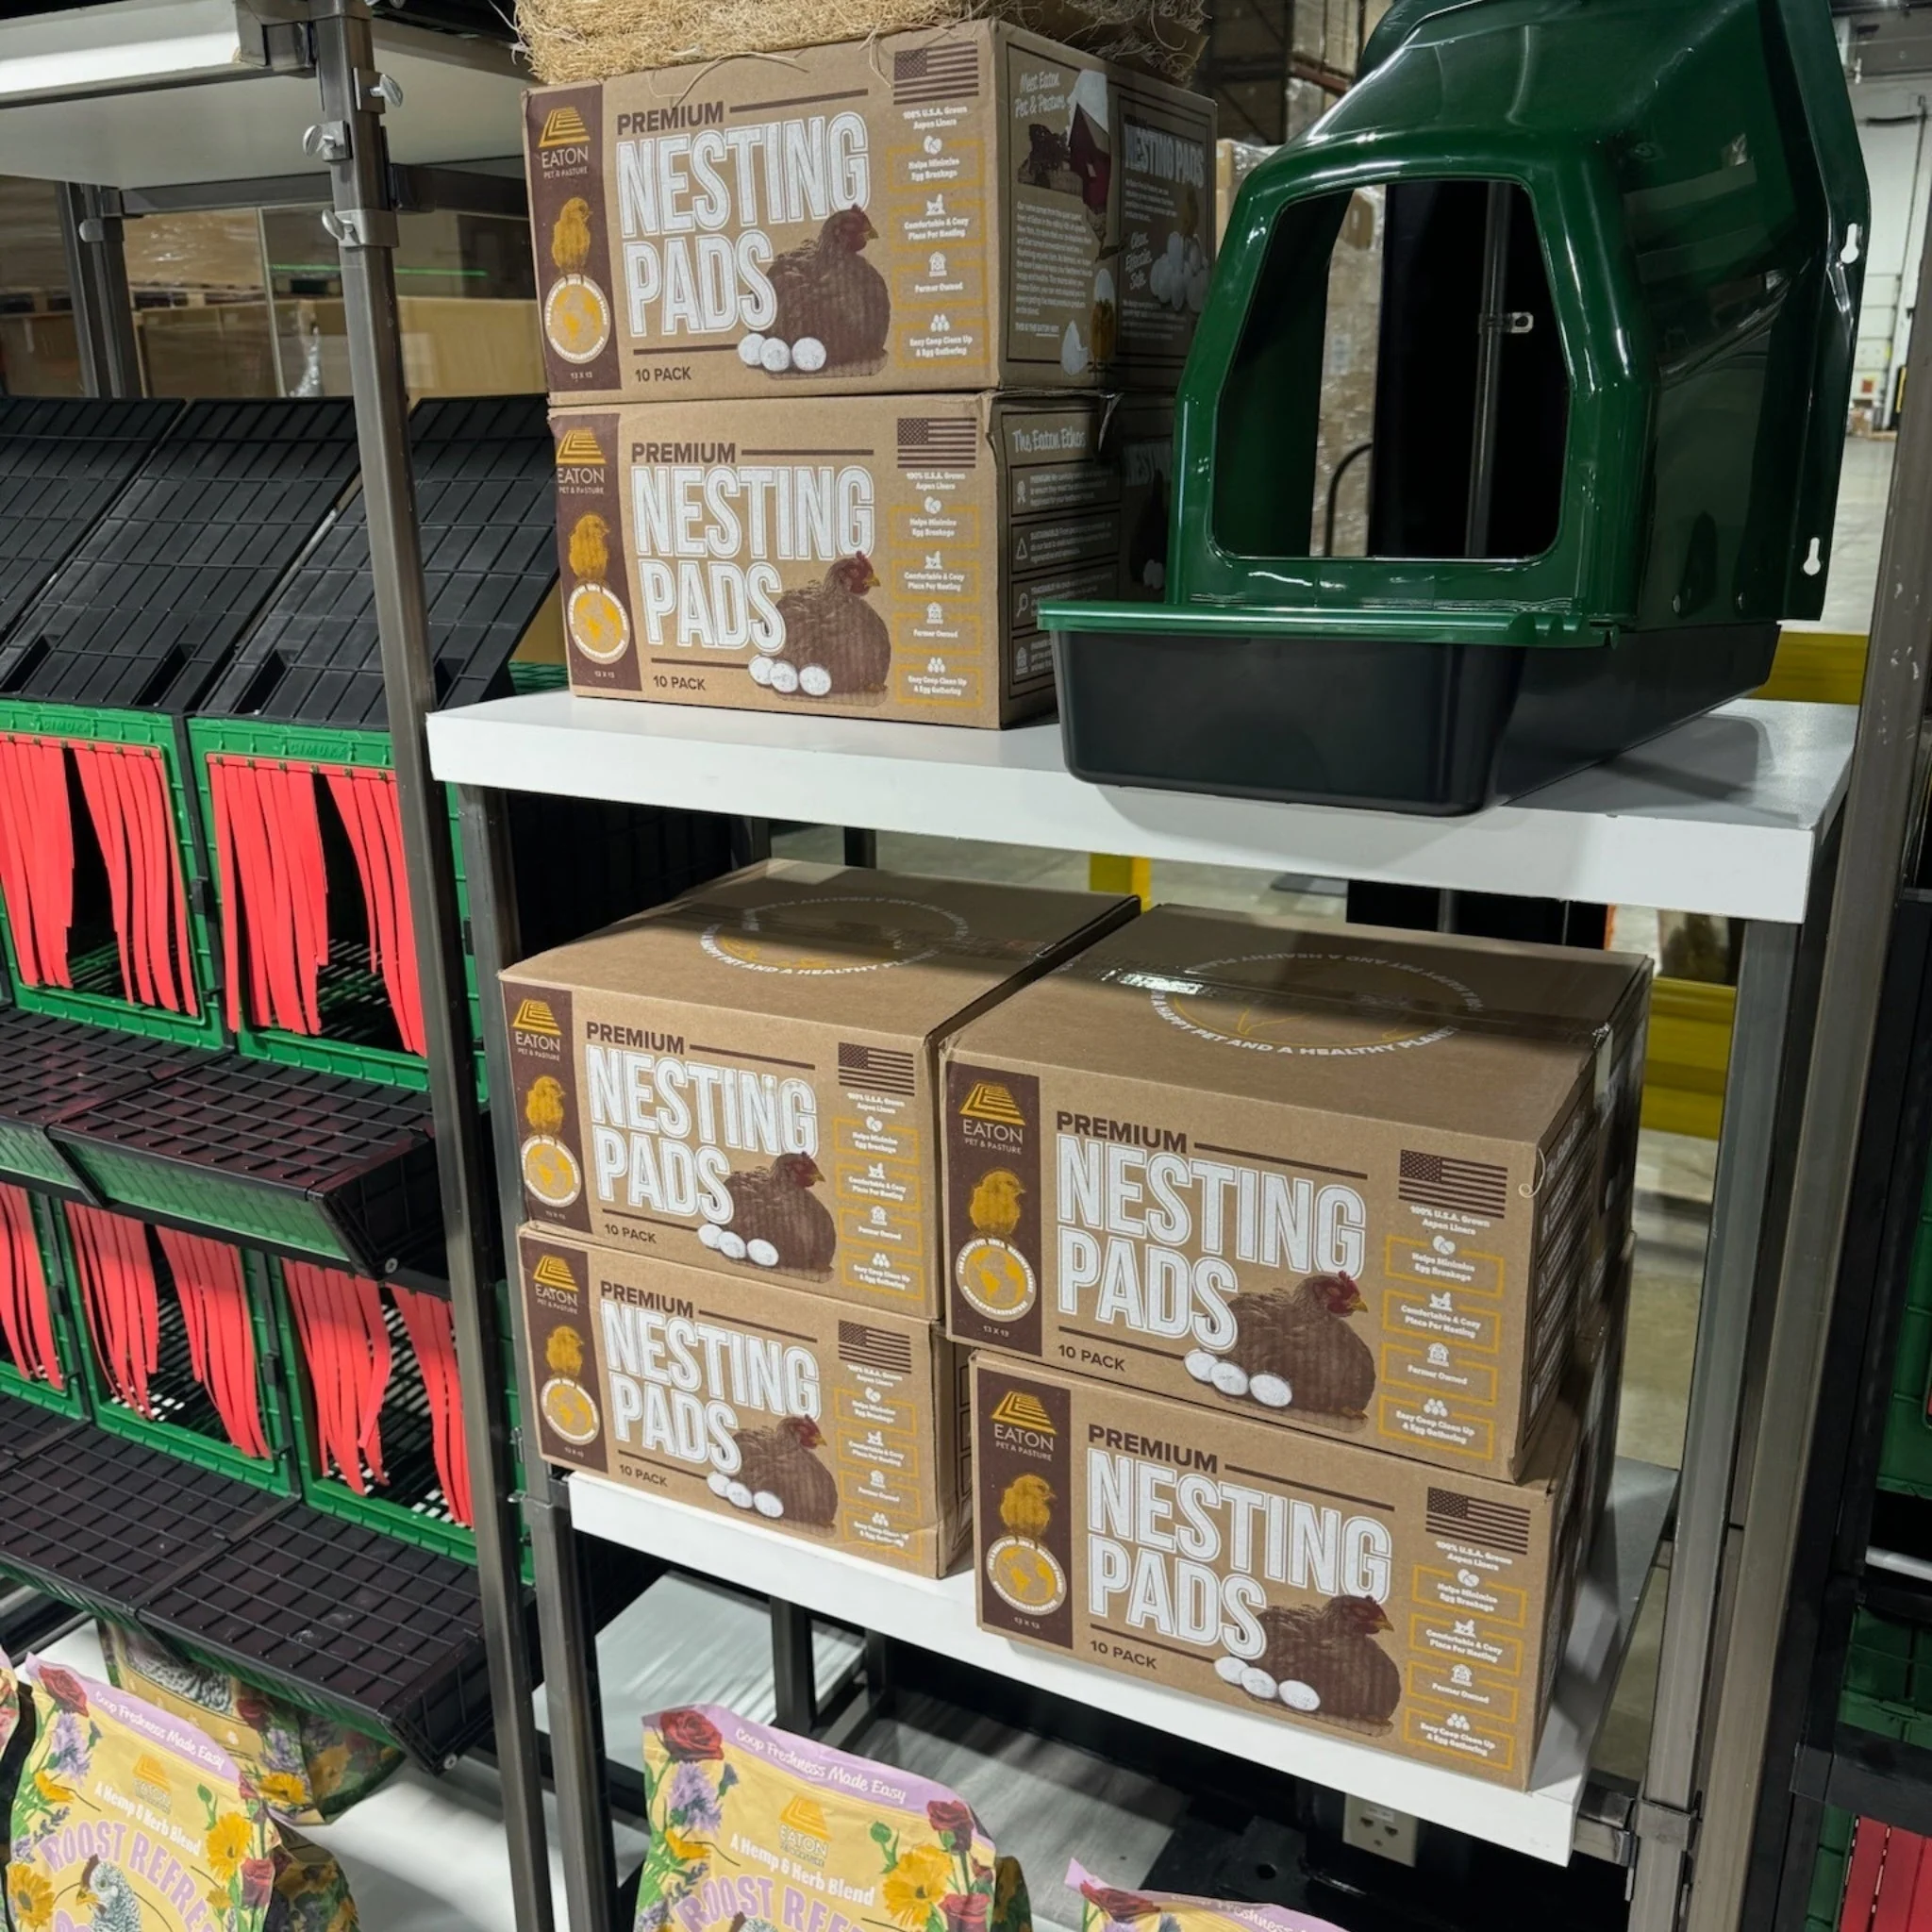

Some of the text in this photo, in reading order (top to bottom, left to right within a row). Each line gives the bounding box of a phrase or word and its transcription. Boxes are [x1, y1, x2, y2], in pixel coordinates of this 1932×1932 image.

[617, 101, 724, 135] PREMIUM
[541, 145, 589, 169] EATON
[616, 111, 870, 238] NESTING
[623, 229, 777, 338] PADS
[635, 366, 691, 382] 10 PACK
[631, 442, 736, 463] PREMIUM
[558, 468, 605, 485] EATON
[630, 466, 874, 561] NESTING
[638, 559, 787, 653] PADS
[653, 675, 706, 692] 10 PACK
[796, 964, 878, 975] HEALTHY
[515, 1032, 560, 1053] EATON
[587, 1021, 685, 1055] PREMIUM
[1154, 1006, 1197, 1030] HAPPY
[1190, 1028, 1229, 1042] PET
[1225, 1039, 1274, 1053] AND
[1277, 1045, 1293, 1055] A
[1300, 1043, 1395, 1057] HEALTHY
[1397, 1025, 1459, 1049] PLANET
[586, 1043, 819, 1158] NESTING
[963, 1119, 1024, 1144] EATON
[965, 1138, 1022, 1156] PET & PASTURE
[1057, 1110, 1187, 1154] PREMIUM
[592, 1124, 734, 1225] PADS
[1057, 1132, 1366, 1281] NESTING
[1434, 1210, 1460, 1223] U.S.A.
[1461, 1215, 1491, 1228] Grown
[605, 1224, 657, 1244] 10 PACK
[1422, 1219, 1476, 1236] Aspen Liners
[535, 1284, 578, 1307] EATON
[600, 1280, 693, 1319] PREMIUM
[1058, 1224, 1239, 1355] PADS
[600, 1298, 821, 1422] NESTING
[1058, 1344, 1125, 1373] 10 PACK
[609, 1370, 742, 1475] PADS
[994, 1424, 1055, 1452] EATON
[995, 1441, 1010, 1451] PET
[1018, 1446, 1053, 1461] PASTURE
[1088, 1424, 1218, 1474] PREMIUM
[619, 1463, 668, 1488] 10 PACK
[1087, 1447, 1392, 1605] NESTING
[1459, 1545, 1484, 1558] U.S.A.
[1088, 1533, 1267, 1660] PADS
[1091, 1640, 1158, 1671] 10 PACK
[117, 1702, 165, 1741] Freshness
[166, 1730, 197, 1757] Made
[197, 1744, 225, 1772] Easy
[735, 1727, 907, 1804] Coop Freshness Made Easy
[95, 1781, 104, 1796] A
[104, 1785, 135, 1818] Hemp
[170, 1824, 202, 1857] Blend
[38, 1821, 126, 1873] ROOST
[779, 1824, 828, 1857] EATON
[730, 1833, 740, 1851] A
[740, 1837, 779, 1873] Hemp
[791, 1863, 825, 1891] Herb
[827, 1876, 875, 1907] Blend
[675, 1874, 774, 1932] ROOST
